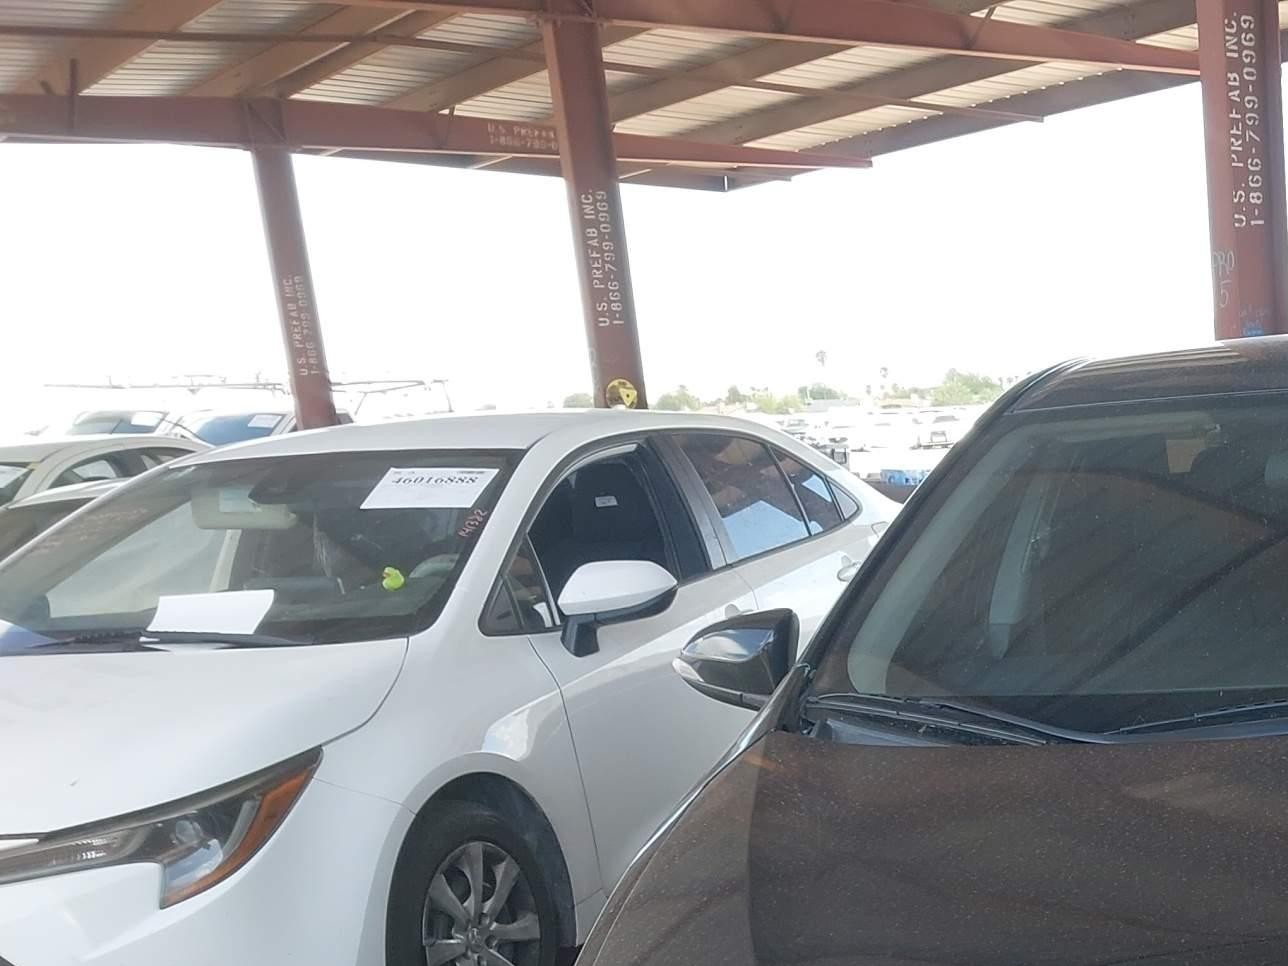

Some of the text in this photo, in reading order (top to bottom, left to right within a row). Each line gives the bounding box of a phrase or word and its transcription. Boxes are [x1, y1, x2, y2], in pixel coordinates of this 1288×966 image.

[1224, 11, 1247, 228] U.S. PREFAB INC.
[1240, 14, 1265, 226] 1-866-799-0969
[581, 189, 611, 327] U.S. PREFAB INC.
[595, 190, 625, 325] 1-866-799-0969
[391, 475, 480, 485] 46016888
